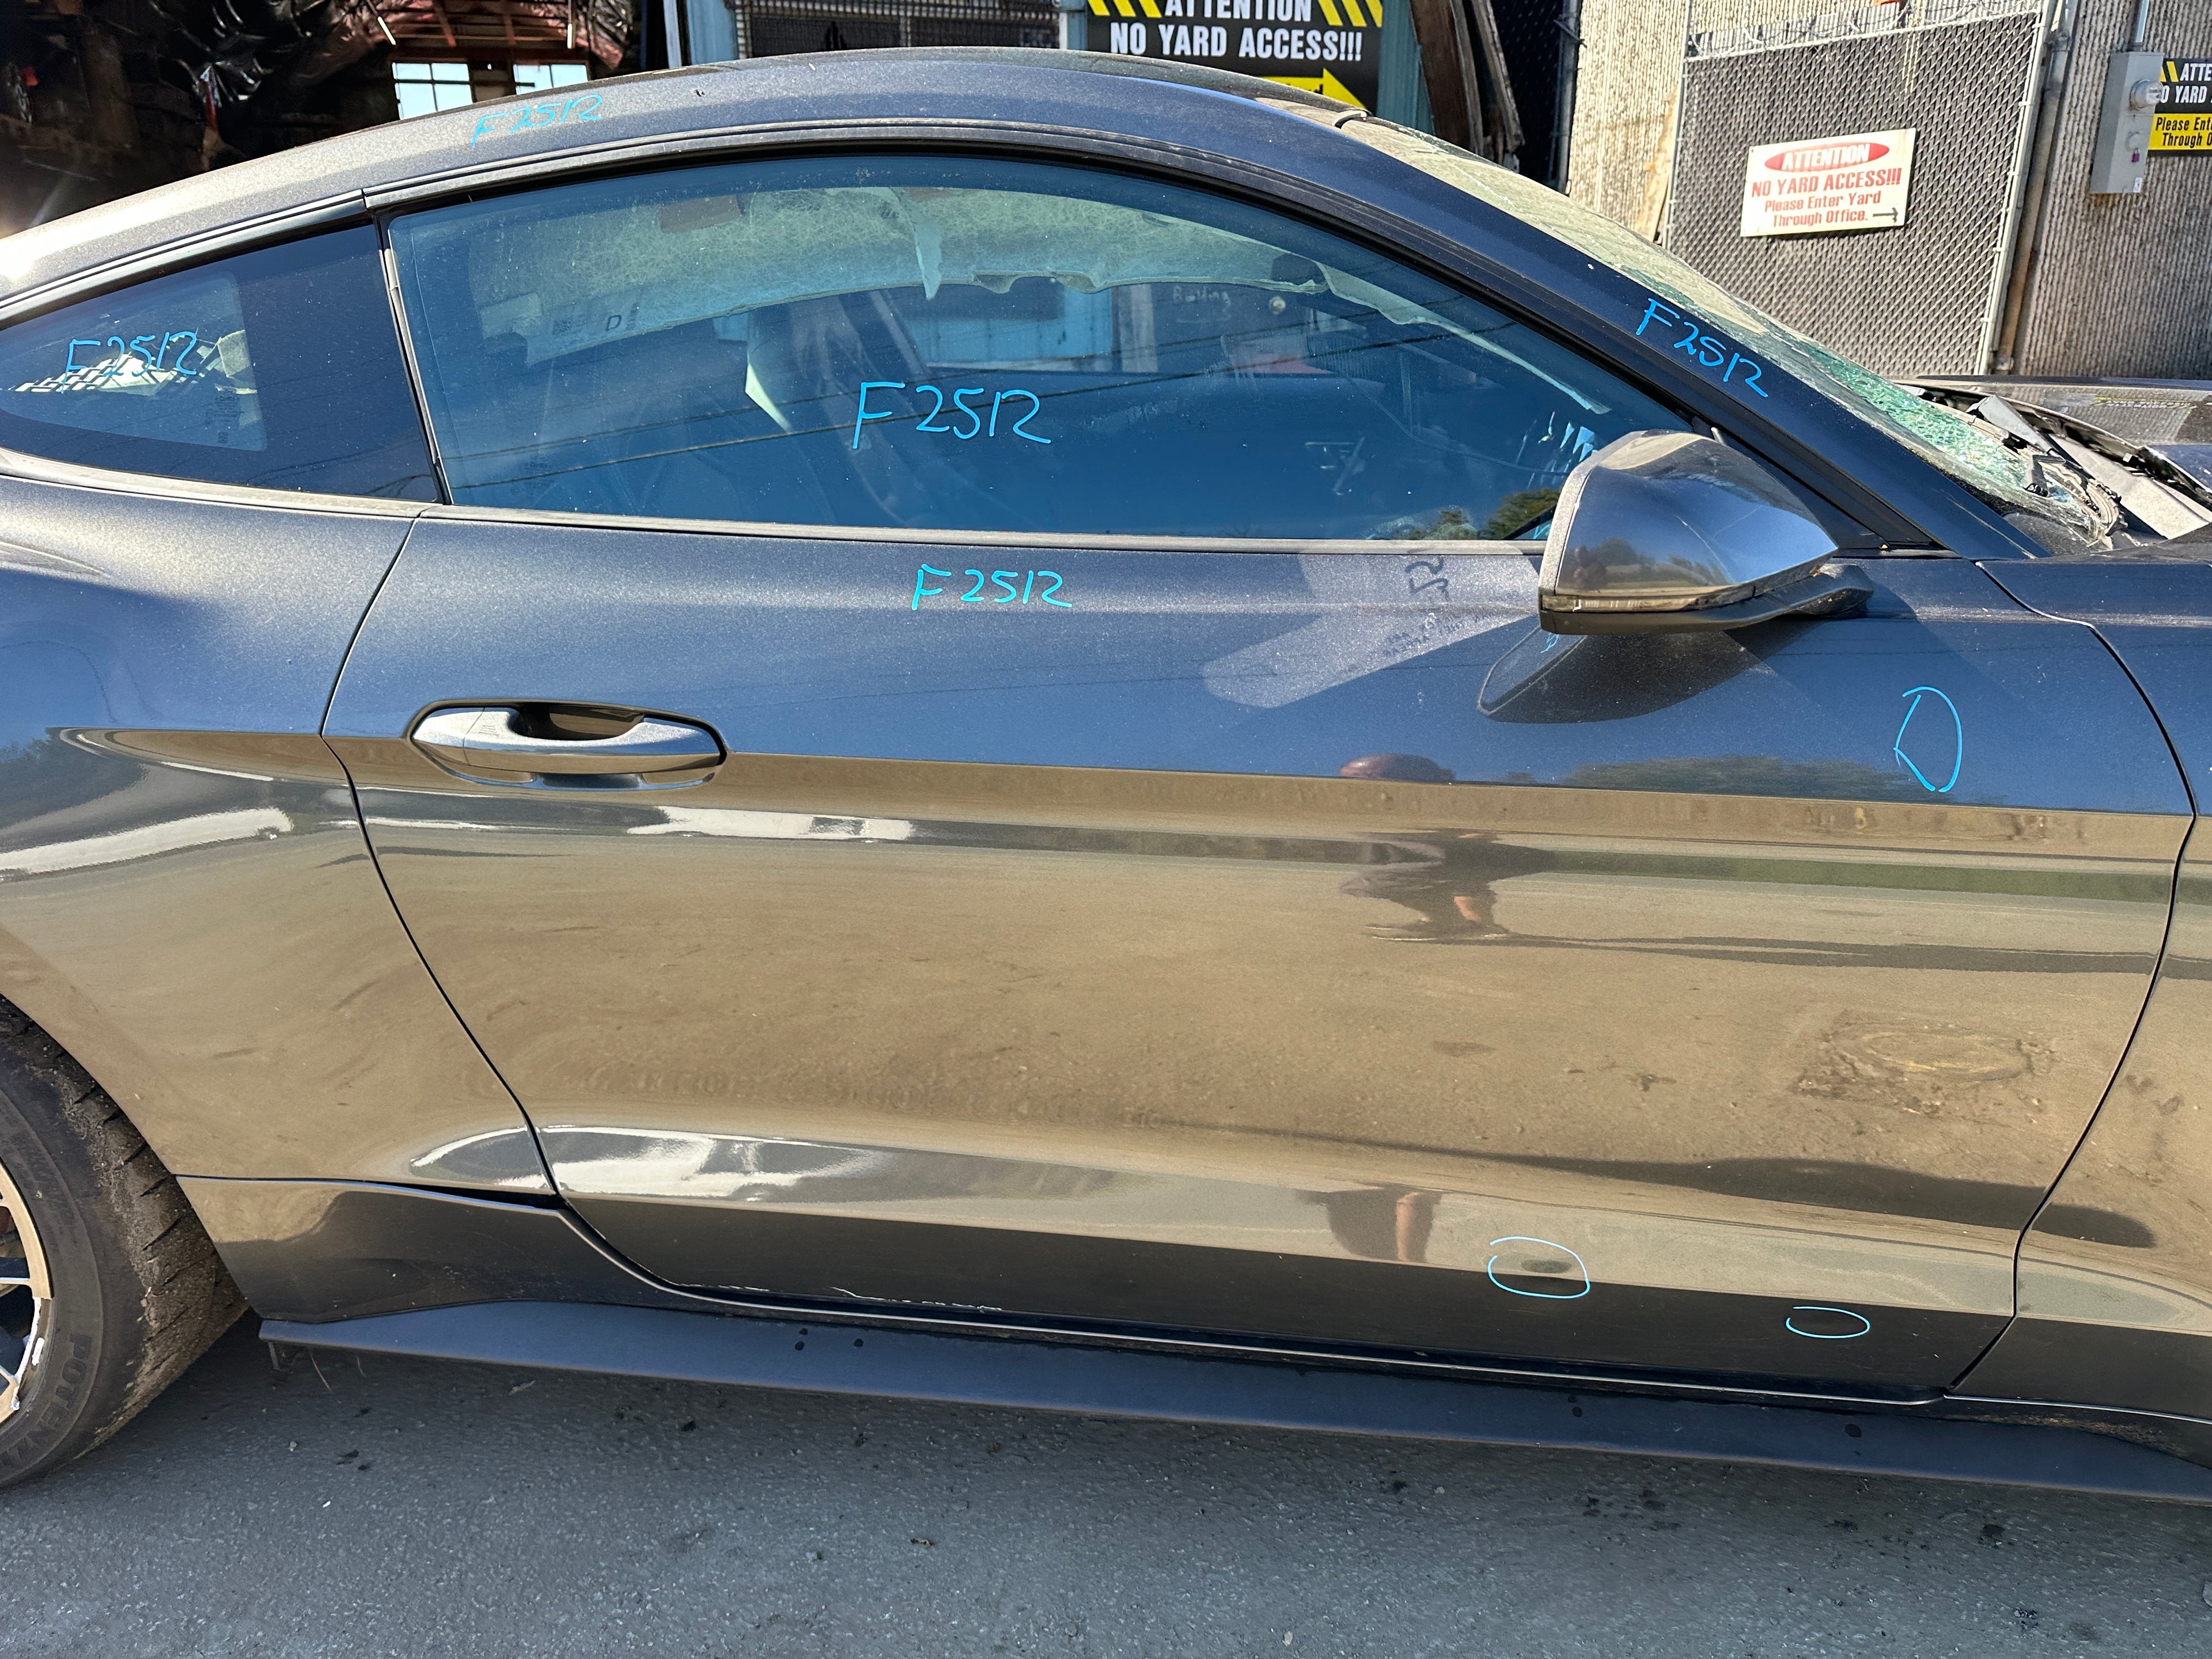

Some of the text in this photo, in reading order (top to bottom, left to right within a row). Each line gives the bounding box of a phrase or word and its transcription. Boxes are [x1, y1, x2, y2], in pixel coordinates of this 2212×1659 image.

[1110, 22, 1362, 61] NO YARD ACCESS!!!
[2175, 85, 2207, 103] YARD
[2156, 117, 2189, 131] Please
[2162, 132, 2202, 148] Through
[1781, 144, 1870, 171] ATTENTION
[1751, 167, 1902, 198] NO YARD ACCESS!!!
[1764, 191, 1881, 212] Please Enter Yard
[1773, 209, 1868, 228] Through Office.
[60, 331, 198, 393] F2512
[1636, 298, 1768, 397] F2512
[853, 381, 1052, 449] F2512
[911, 563, 1073, 611] F2512
